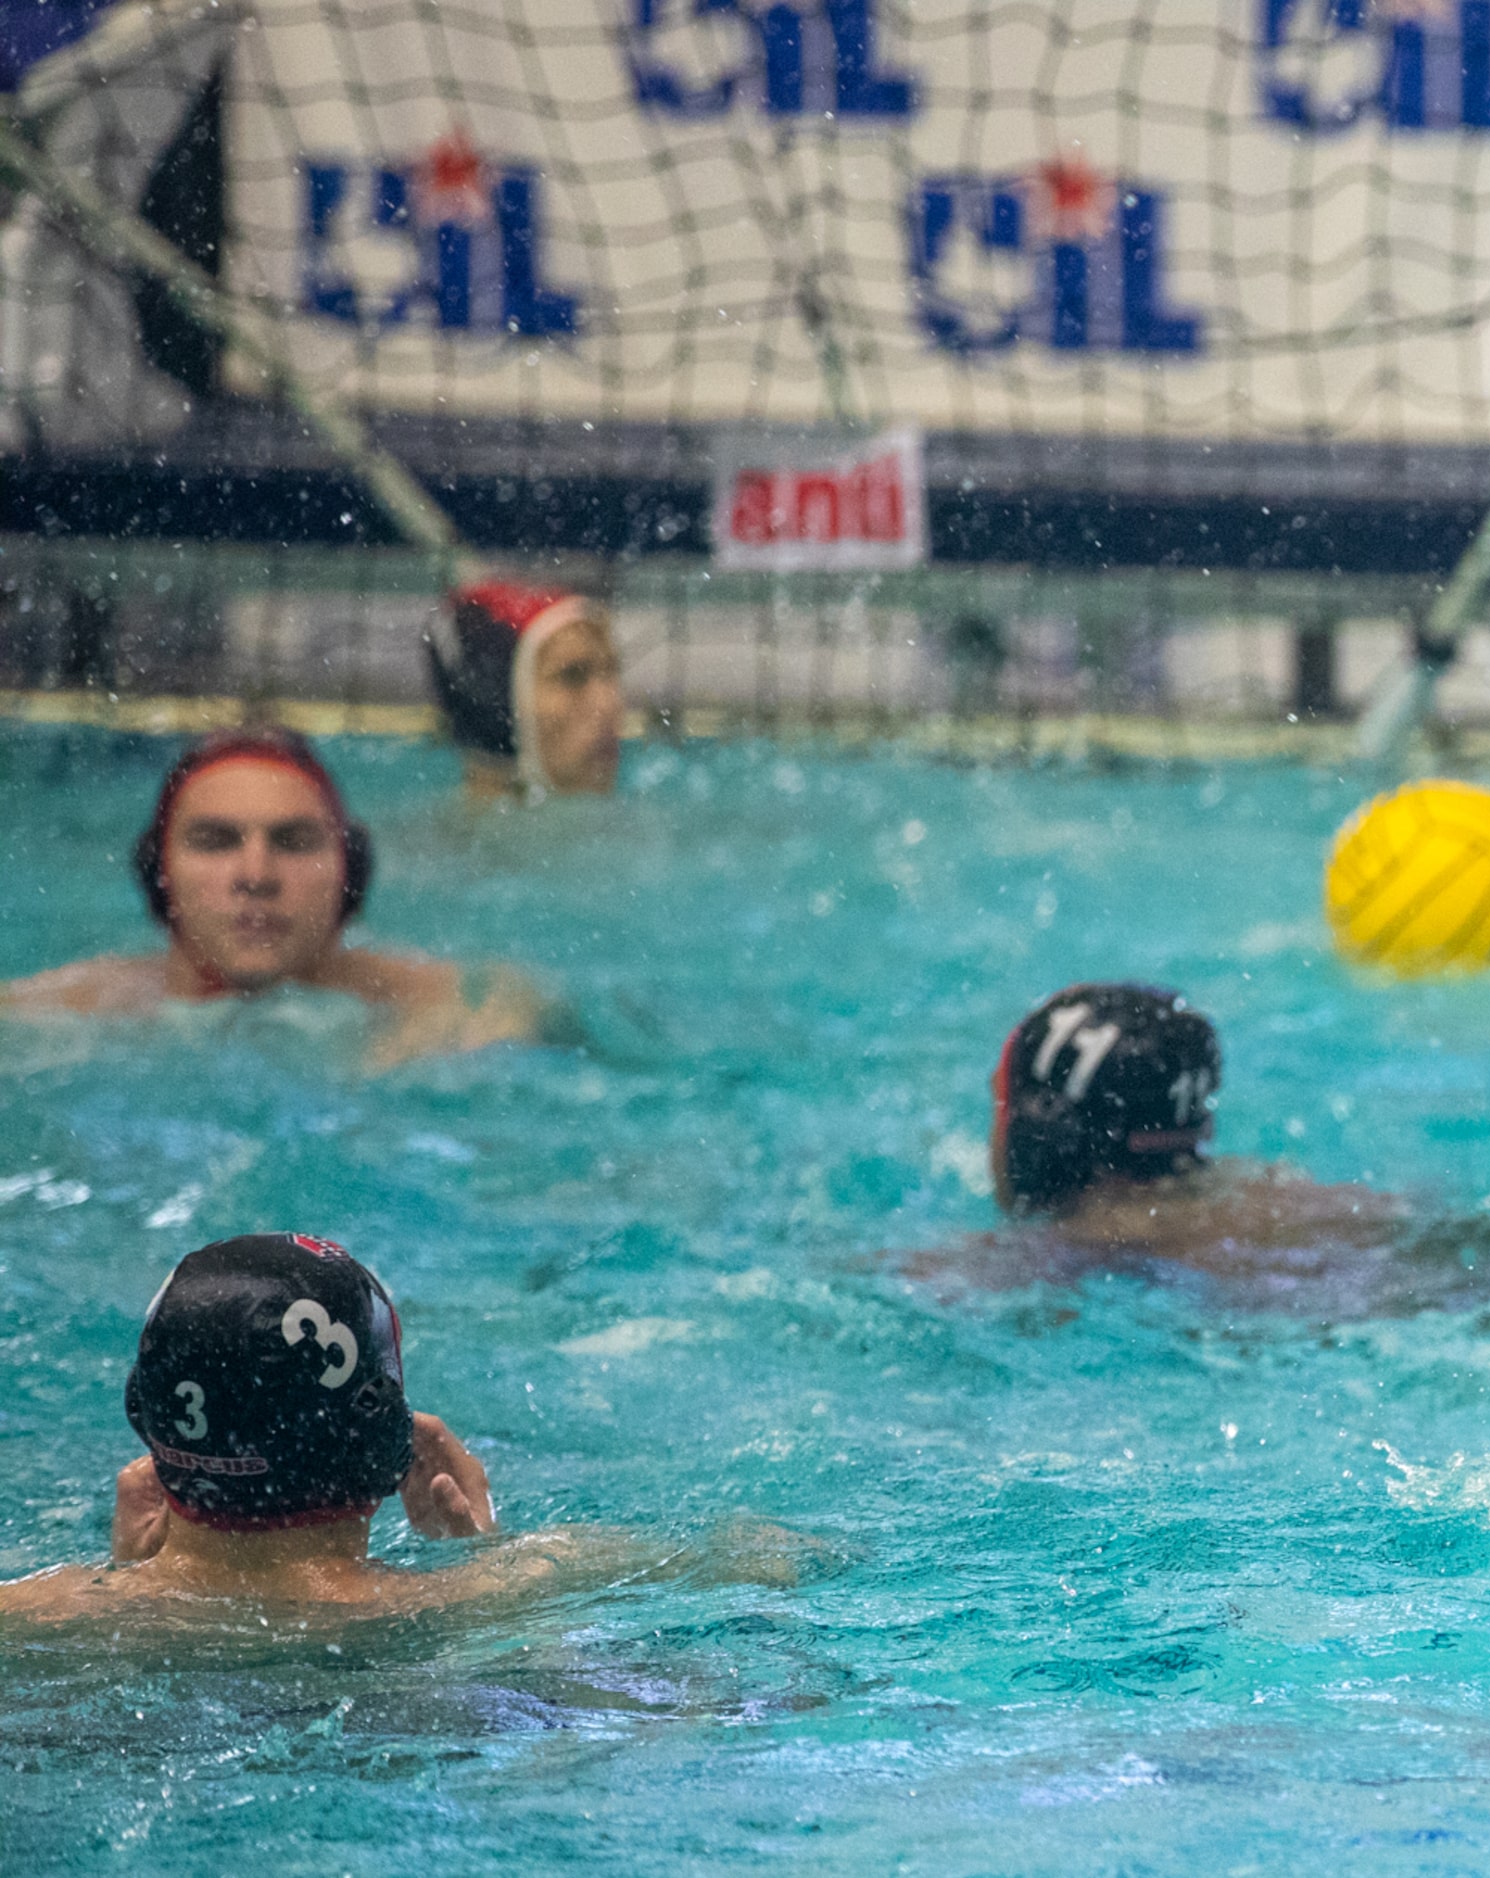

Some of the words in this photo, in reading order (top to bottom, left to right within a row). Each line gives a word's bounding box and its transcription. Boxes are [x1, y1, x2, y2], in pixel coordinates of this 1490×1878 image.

[1033, 1004, 1120, 1102] 11
[281, 1299, 358, 1389] 3
[174, 1381, 209, 1440] 3
